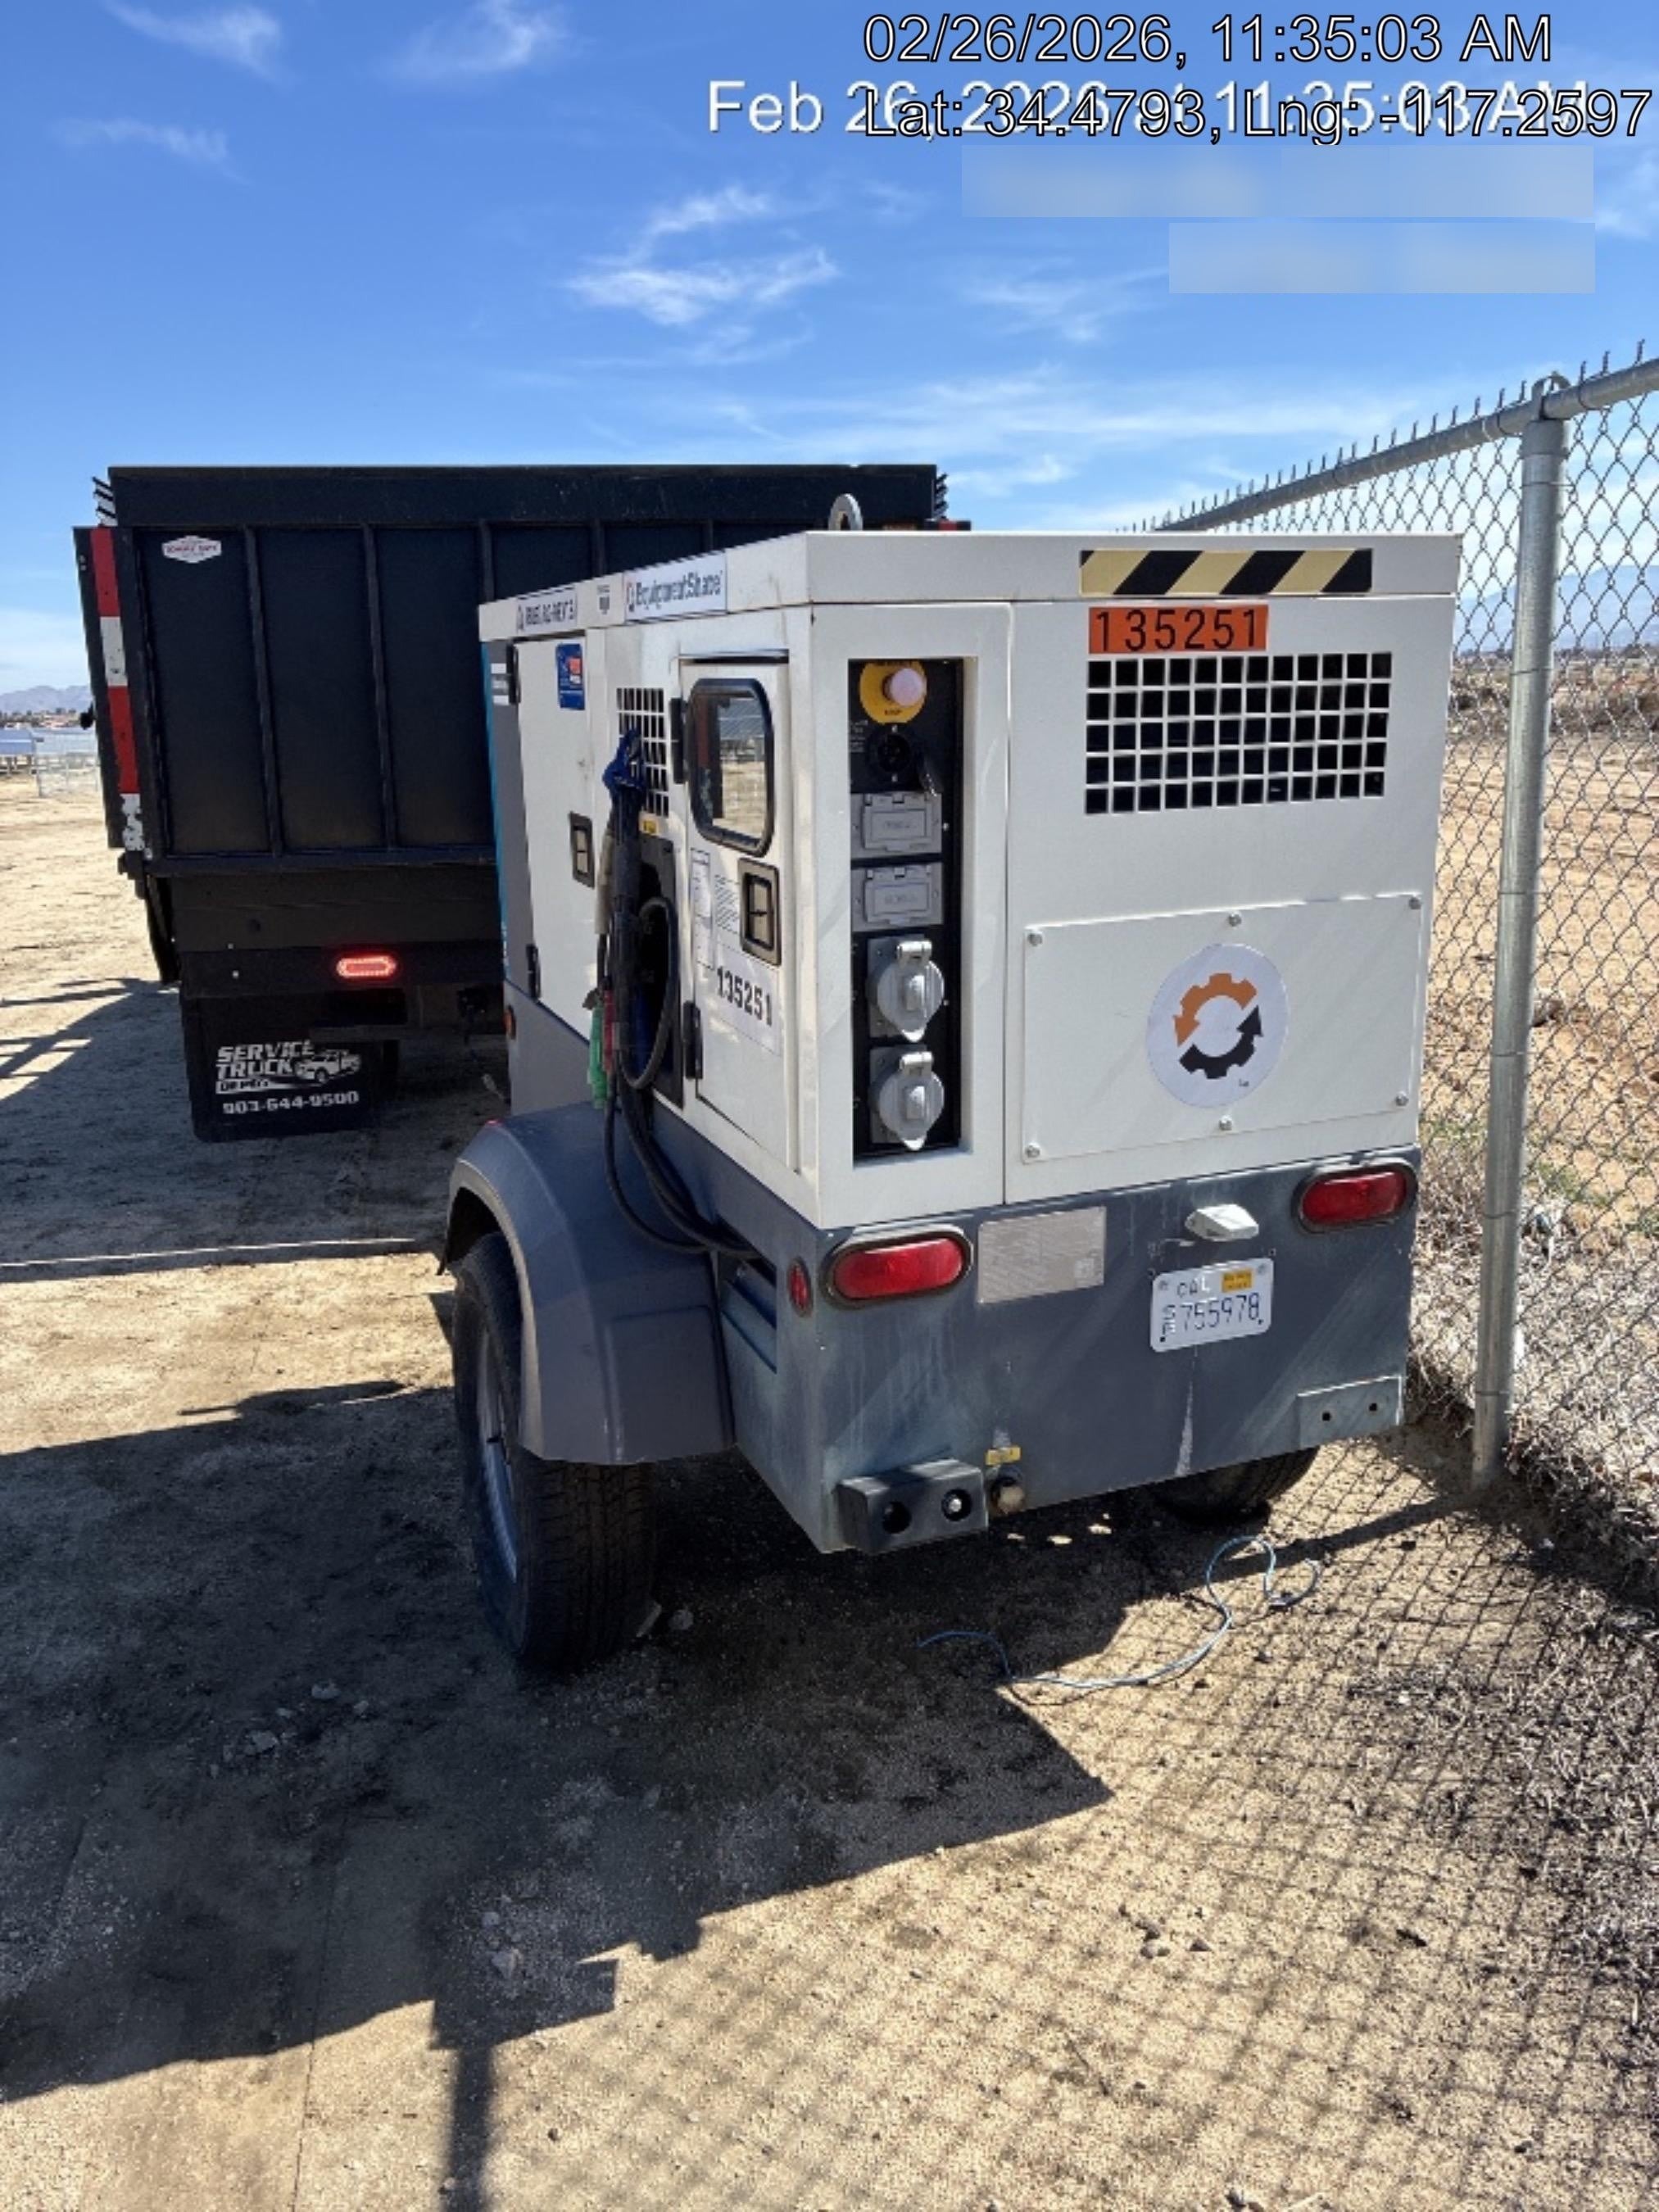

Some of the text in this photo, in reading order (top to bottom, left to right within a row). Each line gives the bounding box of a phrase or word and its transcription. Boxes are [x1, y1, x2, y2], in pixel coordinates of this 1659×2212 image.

[1096, 609, 1258, 652] 135251
[717, 966, 772, 1026] 135251
[216, 1040, 315, 1063] SERVICE
[215, 1058, 293, 1080] TRUCK
[222, 1090, 360, 1115] 903-644-9500
[1180, 1291, 1260, 1331] 755978
